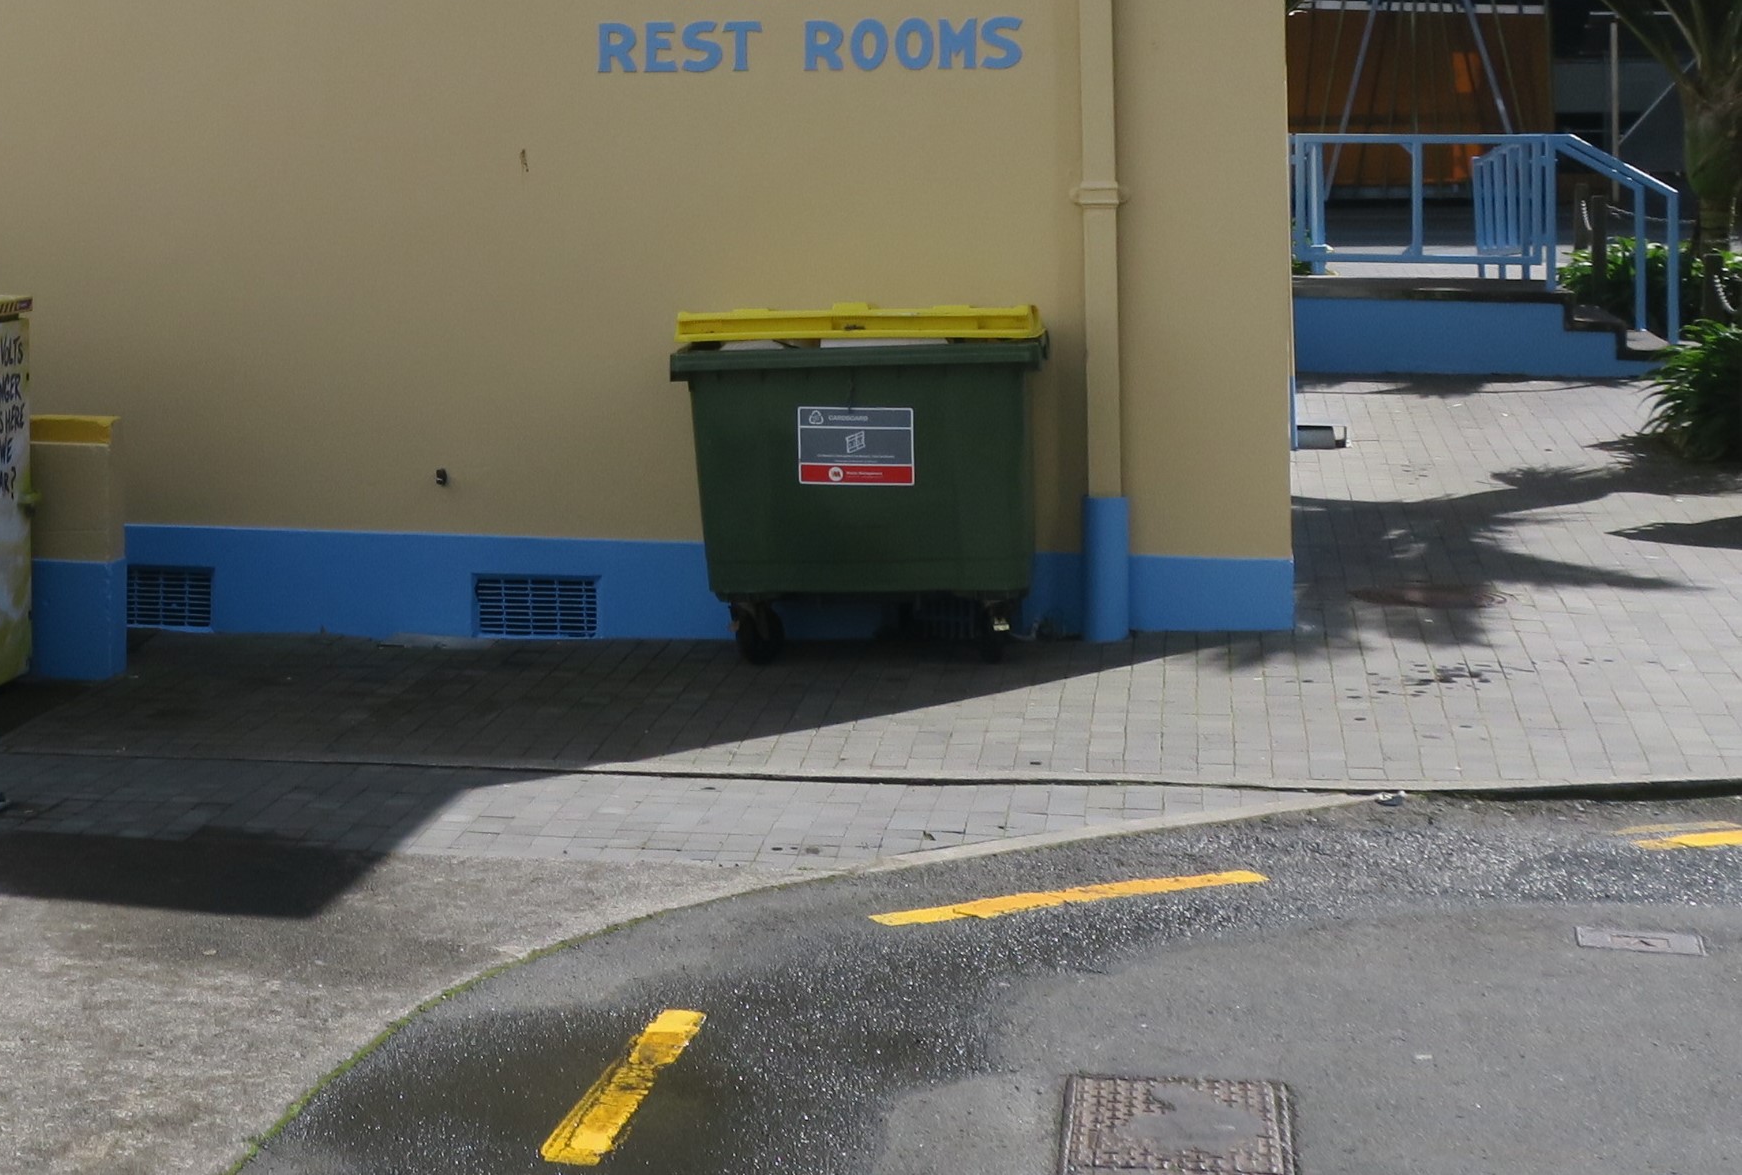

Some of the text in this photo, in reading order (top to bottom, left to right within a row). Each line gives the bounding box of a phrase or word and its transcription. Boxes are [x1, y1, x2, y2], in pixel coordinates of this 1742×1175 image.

[597, 17, 1024, 73] REST ROOMS
[0, 334, 24, 367] VOLTS
[5, 403, 25, 434] HERE
[0, 437, 13, 464] WE
